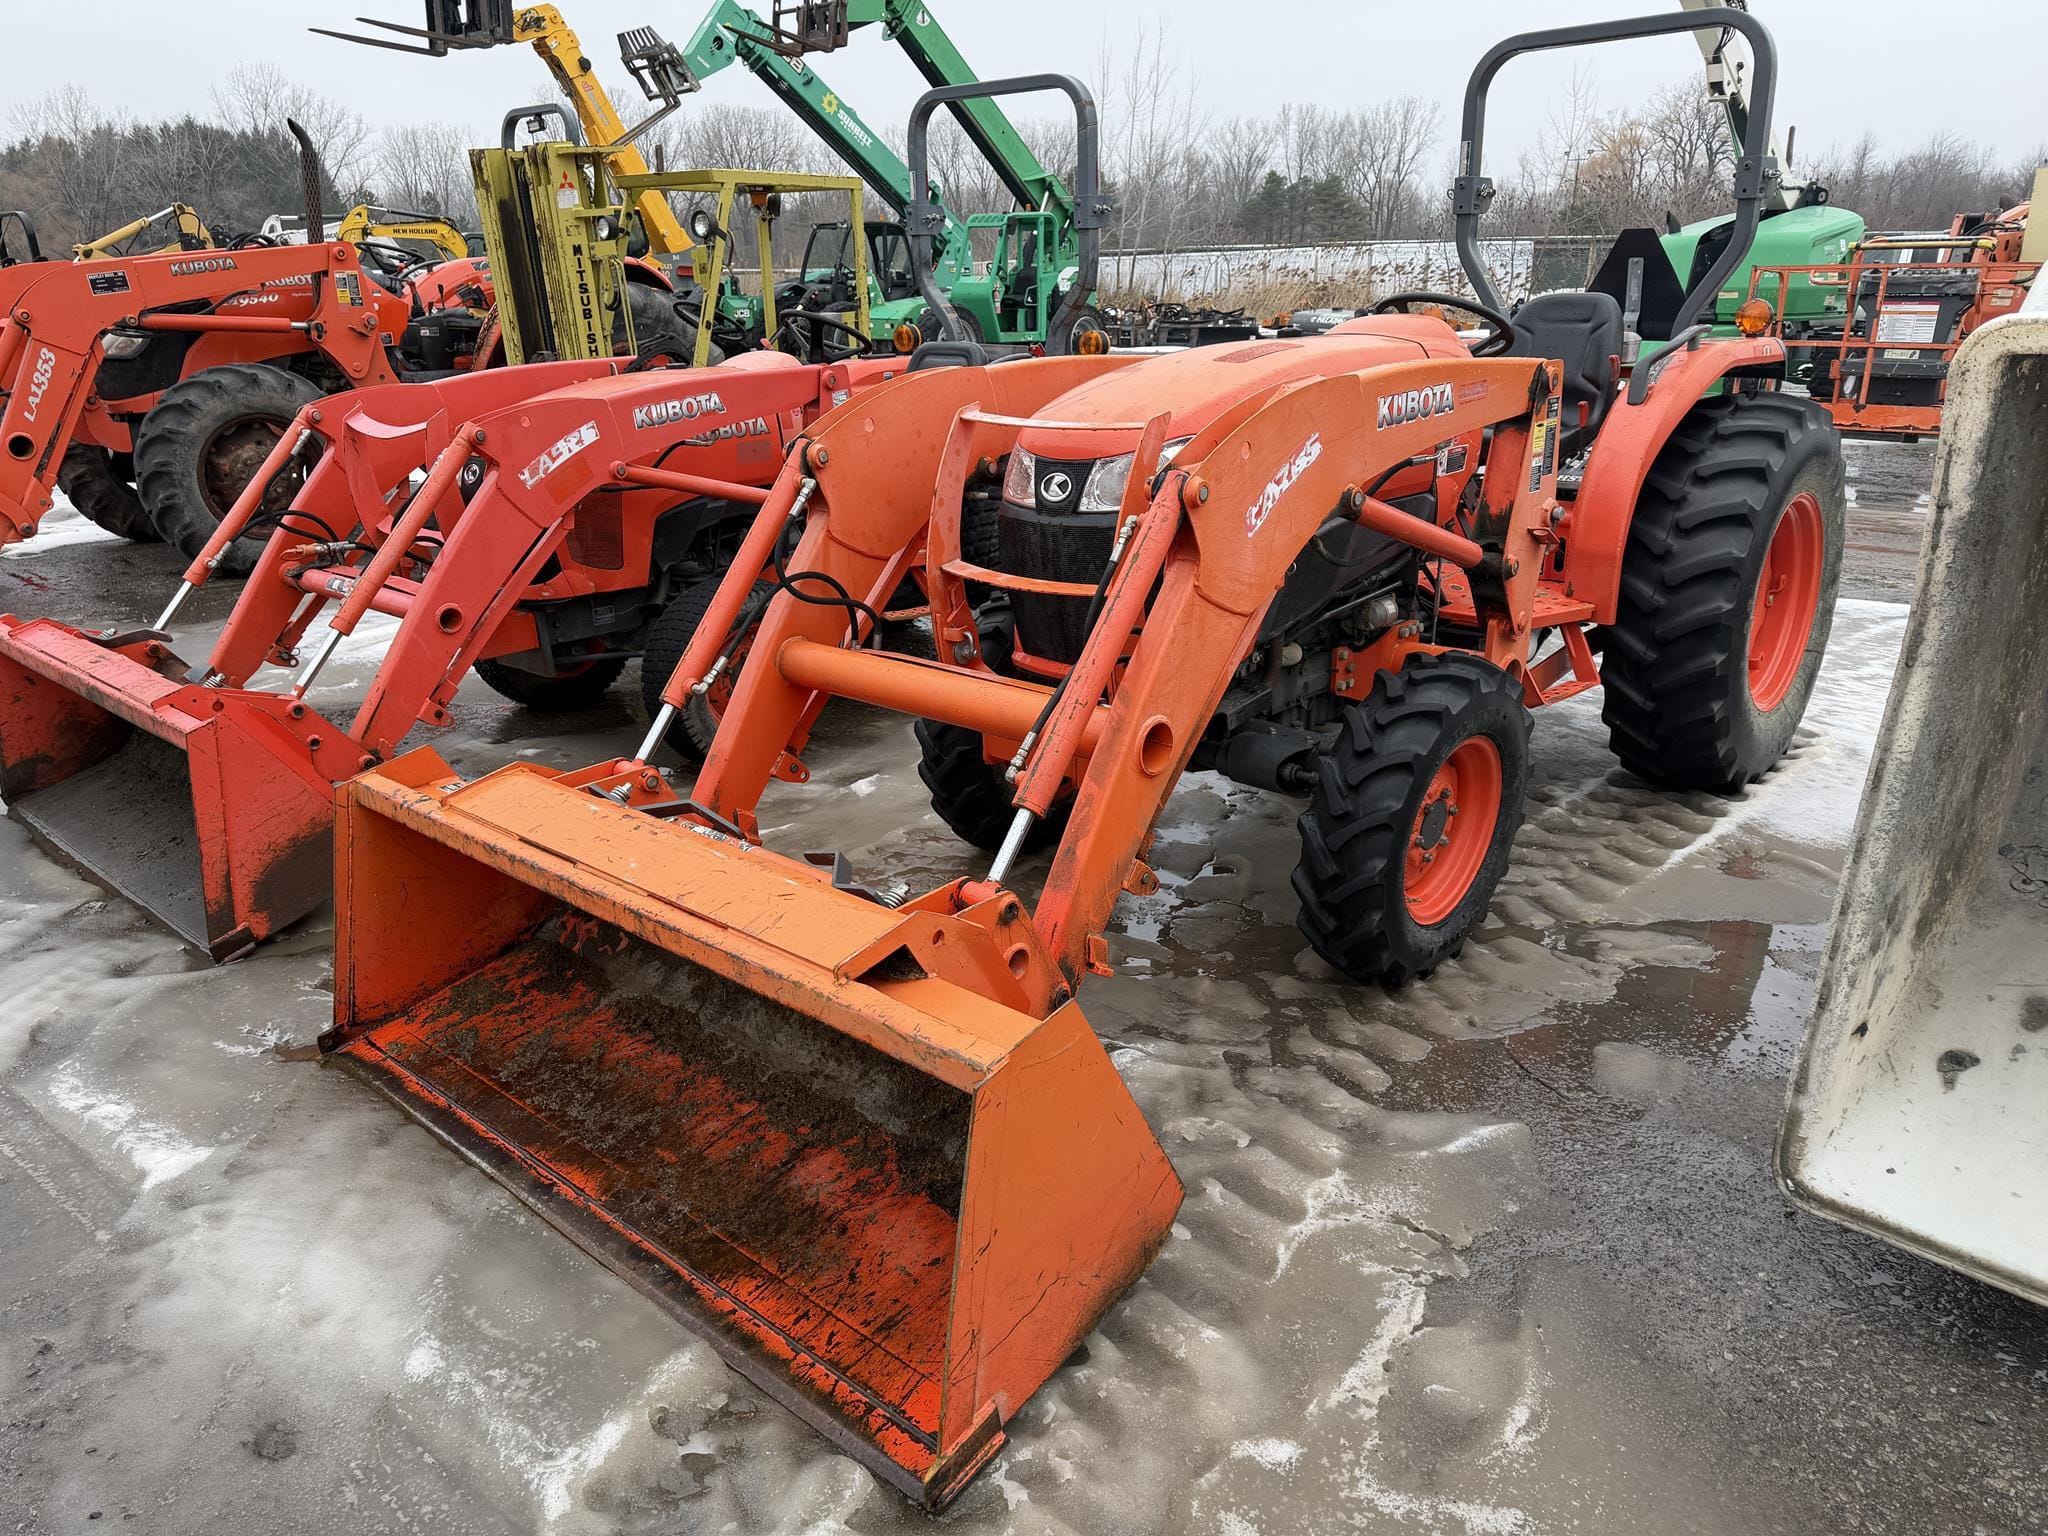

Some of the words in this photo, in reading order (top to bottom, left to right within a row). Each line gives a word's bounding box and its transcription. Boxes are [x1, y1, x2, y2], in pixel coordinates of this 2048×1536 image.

[837, 109, 873, 149] SUNBELT
[169, 257, 238, 276] KUBOTA
[264, 274, 313, 287] KUBOT
[572, 243, 600, 357] MITSUBISH
[733, 309, 751, 318] JCB
[23, 347, 56, 423] LA1353
[633, 391, 727, 430] KUBOTA
[1377, 381, 1455, 431] KUBOTA
